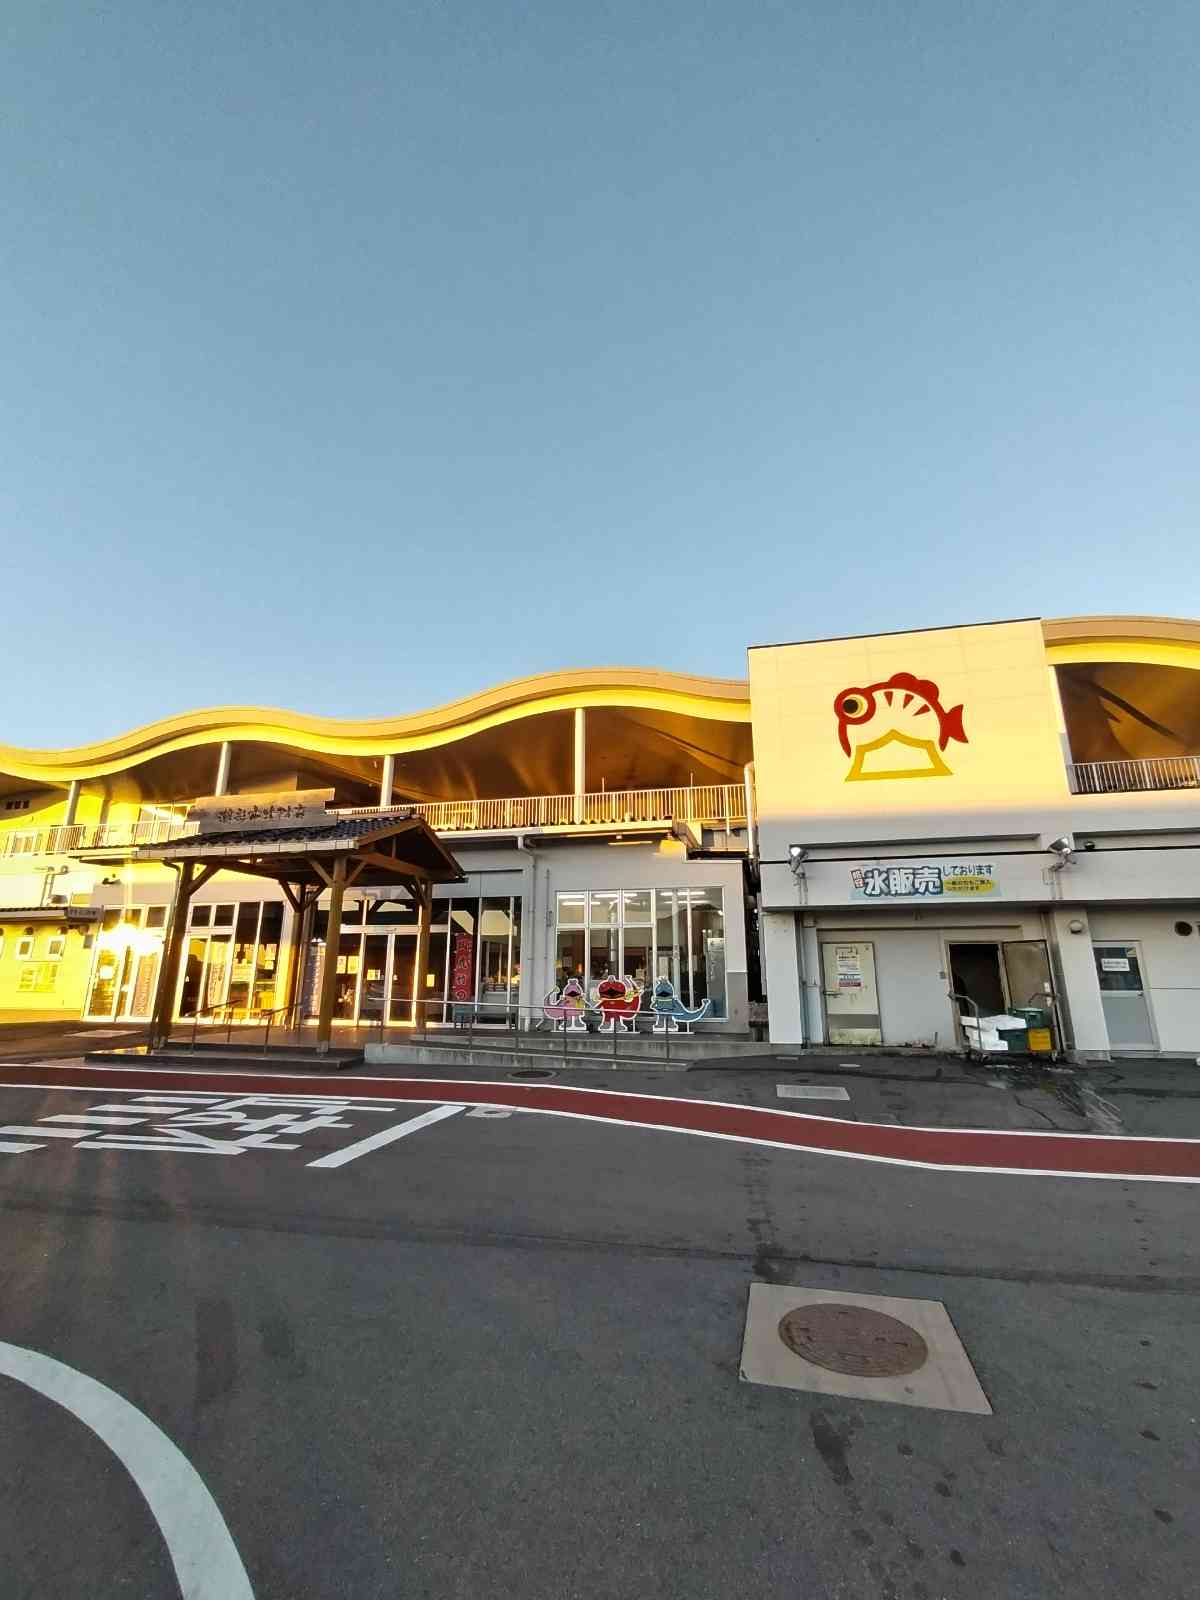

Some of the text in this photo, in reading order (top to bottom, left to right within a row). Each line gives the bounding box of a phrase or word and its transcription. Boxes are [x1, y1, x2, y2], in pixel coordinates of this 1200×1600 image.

[864, 867, 942, 896] 氷販売
[943, 865, 992, 877] しております
